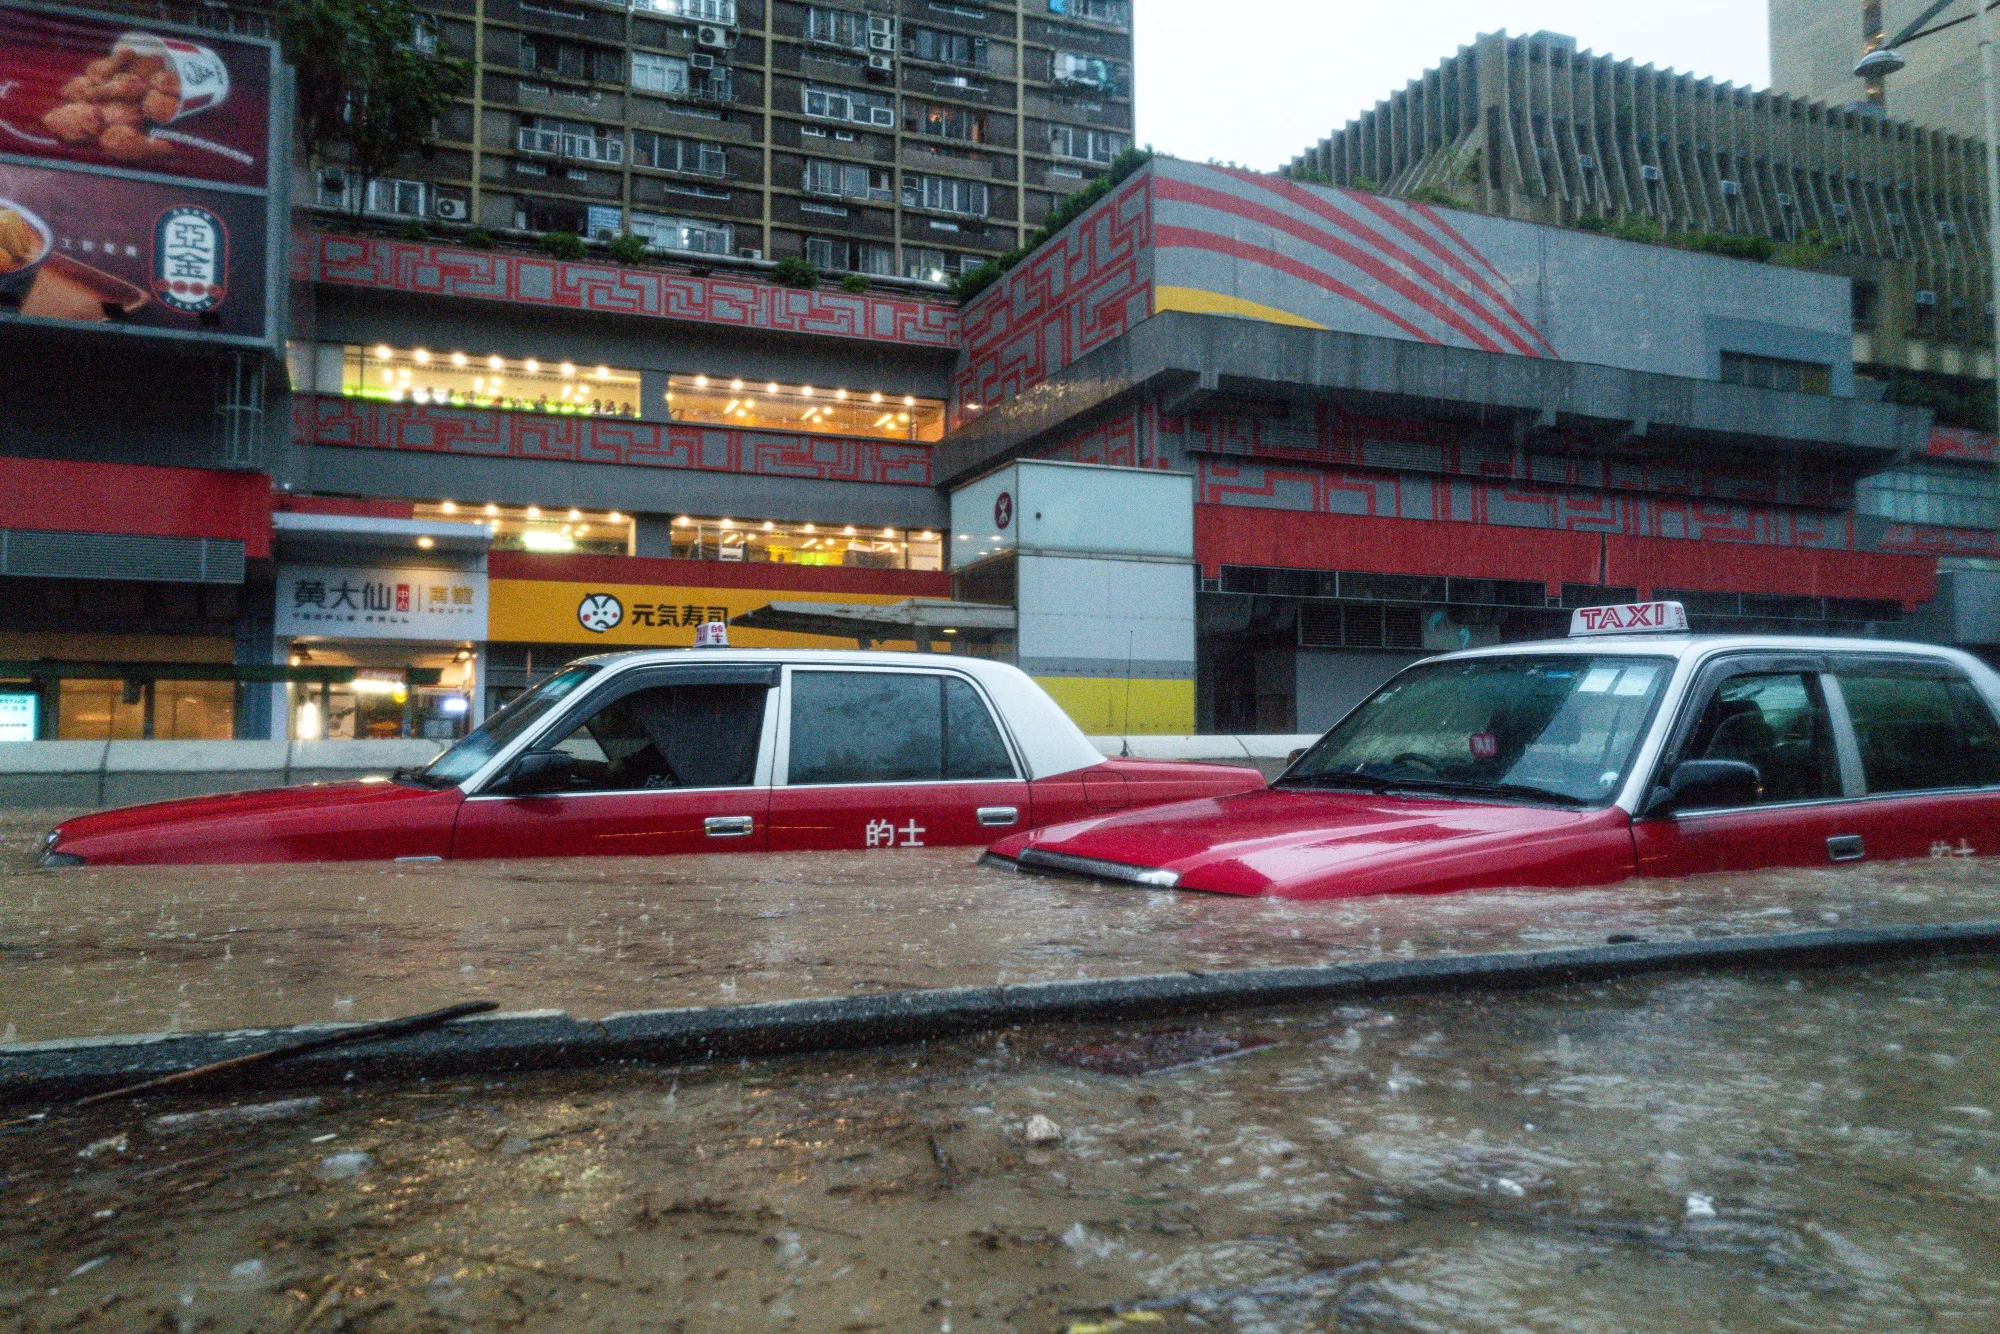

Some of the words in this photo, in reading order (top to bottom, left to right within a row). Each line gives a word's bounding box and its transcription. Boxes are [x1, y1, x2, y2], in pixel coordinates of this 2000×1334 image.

[632, 604, 728, 628] 元気寿司
[1580, 603, 1664, 629] TAXI
[866, 819, 926, 846] 的士
